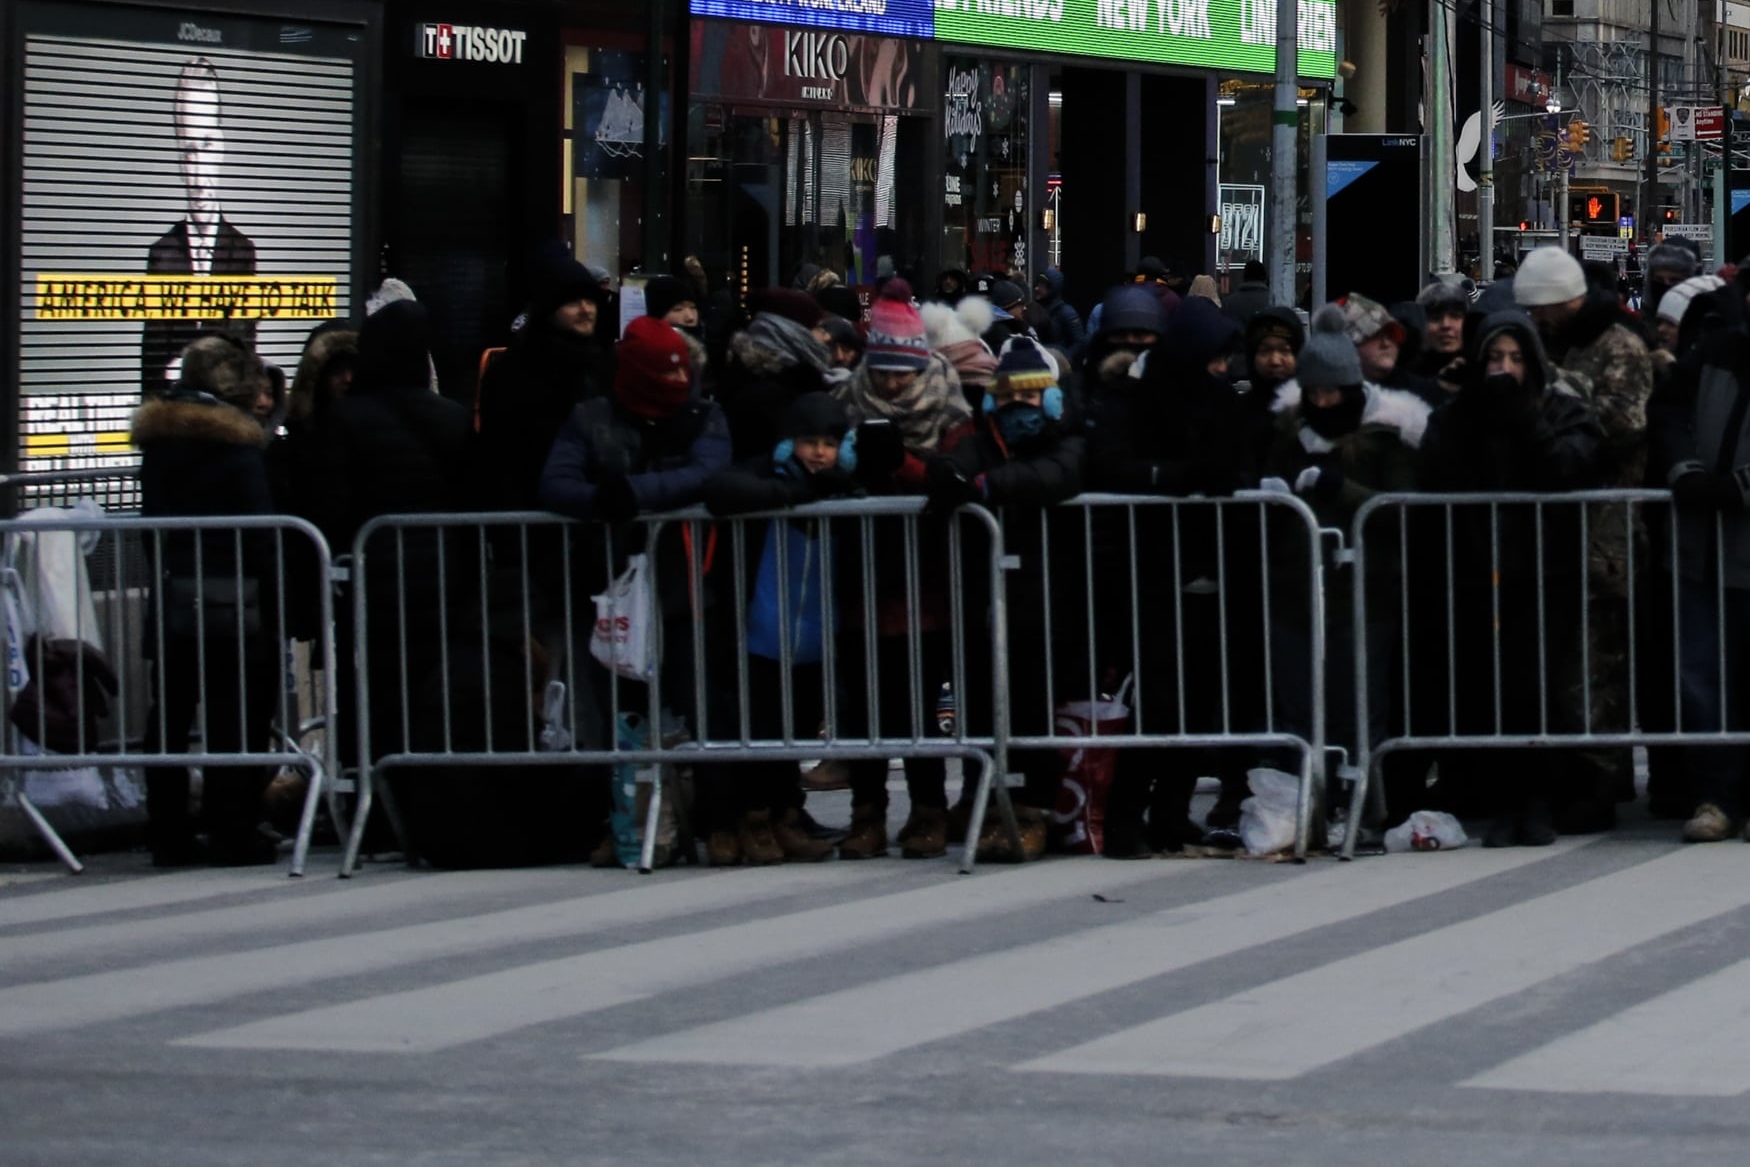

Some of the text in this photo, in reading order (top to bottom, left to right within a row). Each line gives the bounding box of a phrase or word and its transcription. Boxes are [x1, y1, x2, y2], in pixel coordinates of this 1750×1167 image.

[453, 25, 527, 65] TISSOT
[784, 29, 849, 81] KIKO
[948, 64, 979, 109] Happy
[1382, 137, 1417, 147] LinkNYC
[976, 218, 1001, 234] WINTER
[259, 280, 282, 318] TO
[290, 280, 335, 318] TALK
